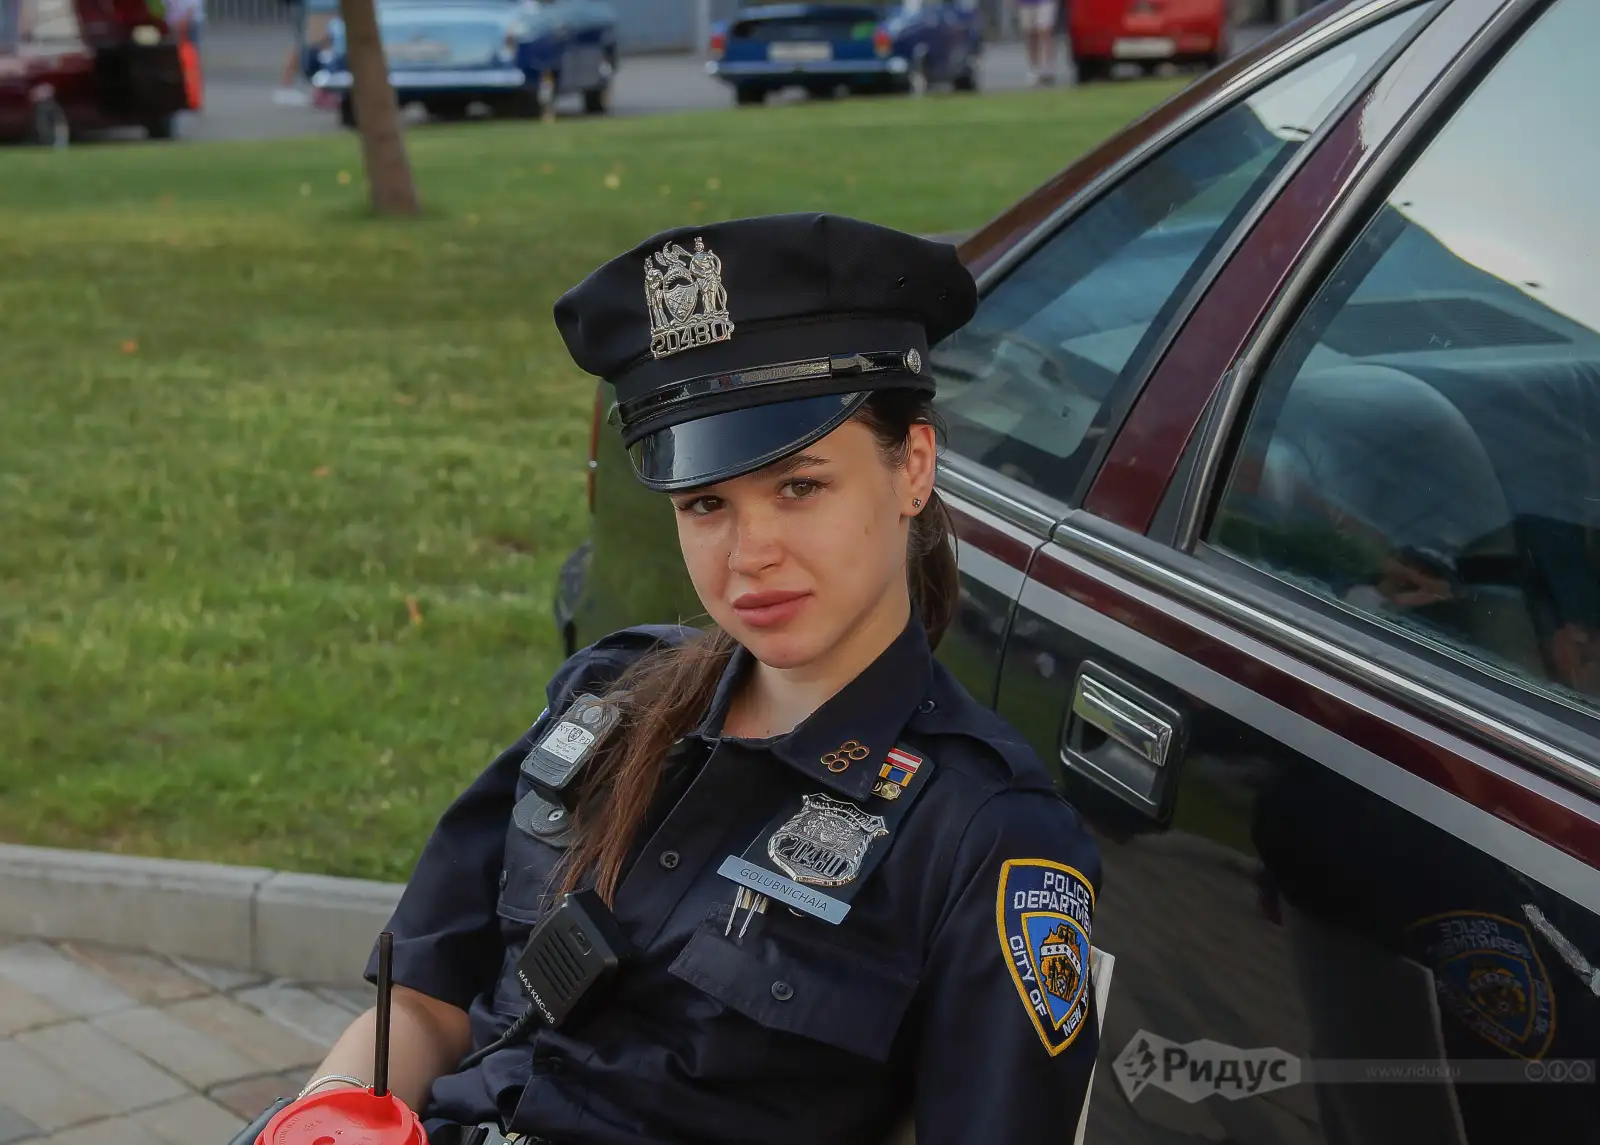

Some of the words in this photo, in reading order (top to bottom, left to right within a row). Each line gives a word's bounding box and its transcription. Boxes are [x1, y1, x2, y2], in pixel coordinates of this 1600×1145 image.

[650, 319, 729, 358] 20480
[779, 836, 847, 877] 20480
[739, 867, 828, 912] GOLUBNICHAIA
[1043, 871, 1090, 912] POLICE
[518, 969, 533, 992] MAX
[1009, 935, 1036, 983] CITY
[1029, 988, 1048, 1017] OF
